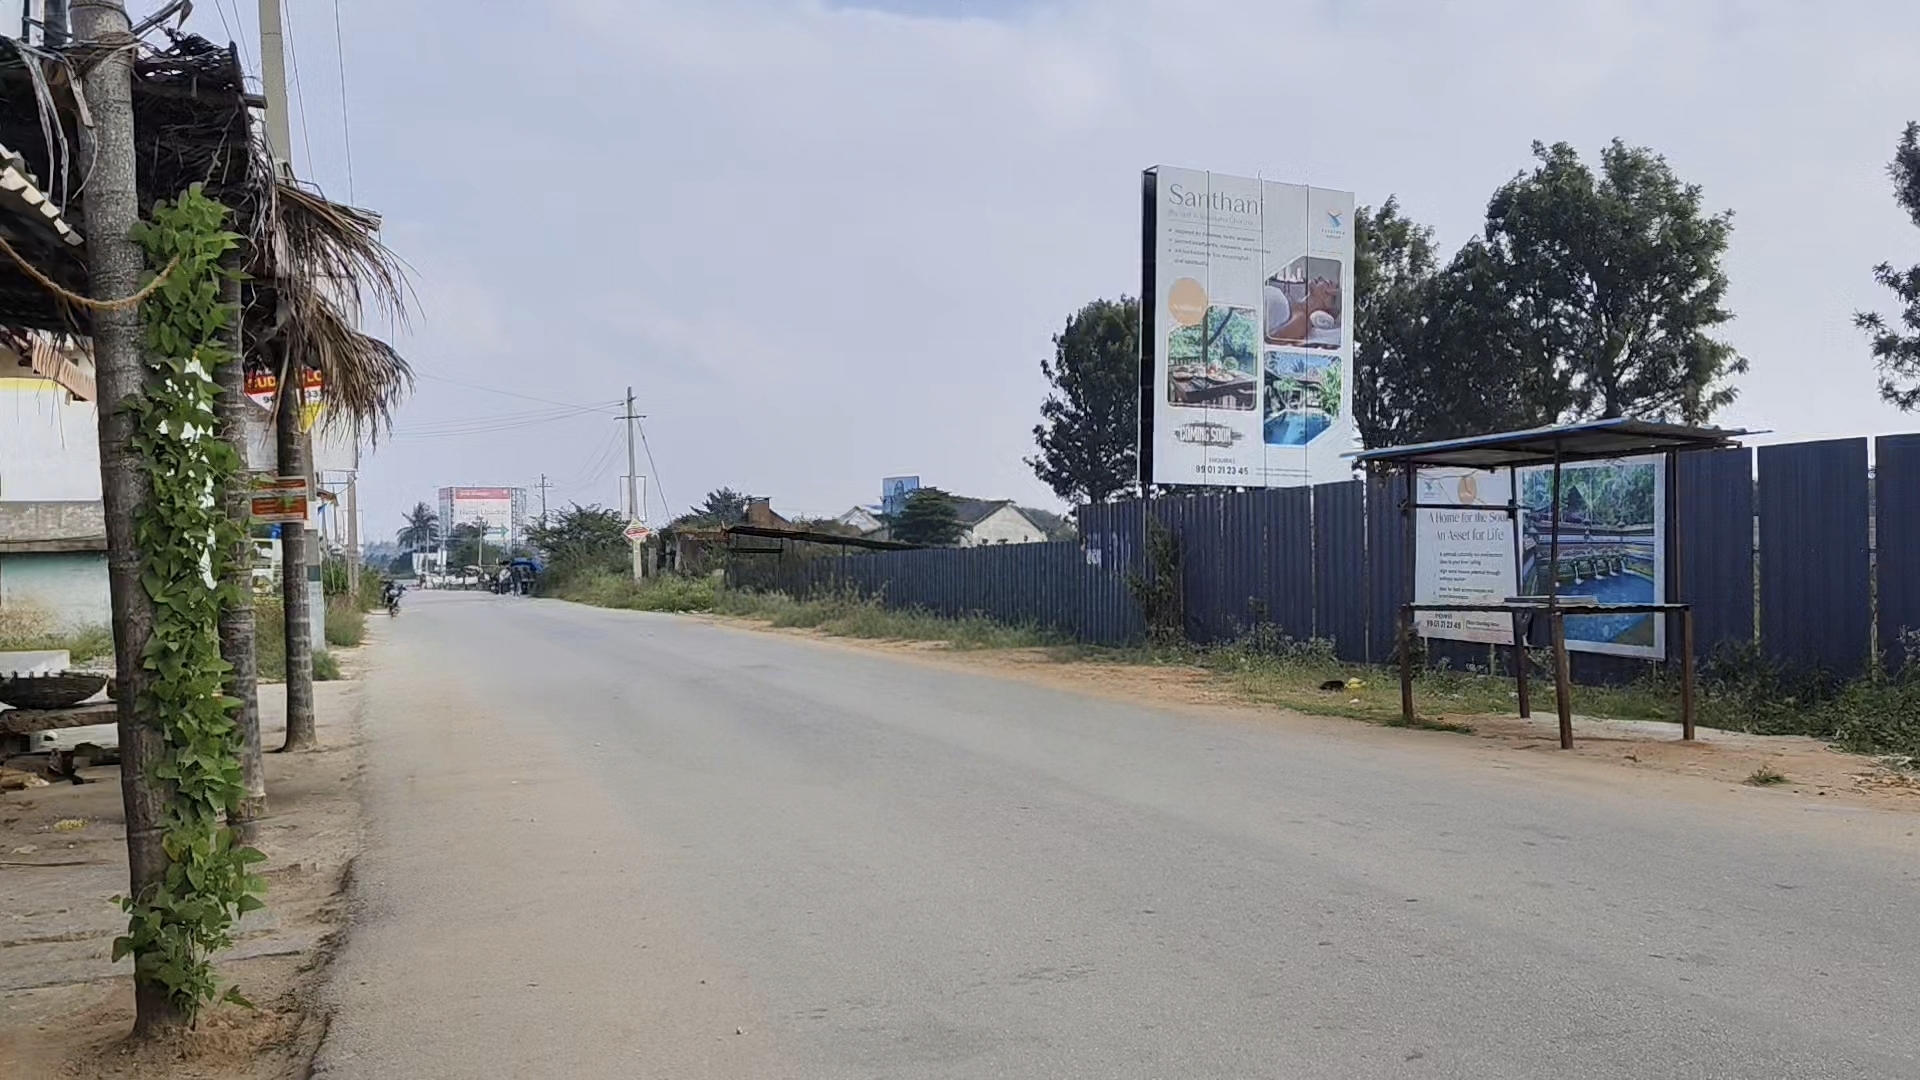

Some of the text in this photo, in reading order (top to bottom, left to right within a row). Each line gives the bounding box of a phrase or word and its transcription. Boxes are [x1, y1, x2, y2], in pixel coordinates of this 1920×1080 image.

[1179, 425, 1231, 443] COMING SOON
[1238, 466, 1249, 476] 45
[1435, 511, 1460, 524] Home
[1461, 511, 1474, 523] for
[1474, 511, 1488, 523] the
[1448, 529, 1470, 541] Asset
[1472, 527, 1485, 541] for
[1486, 527, 1505, 541] Life
